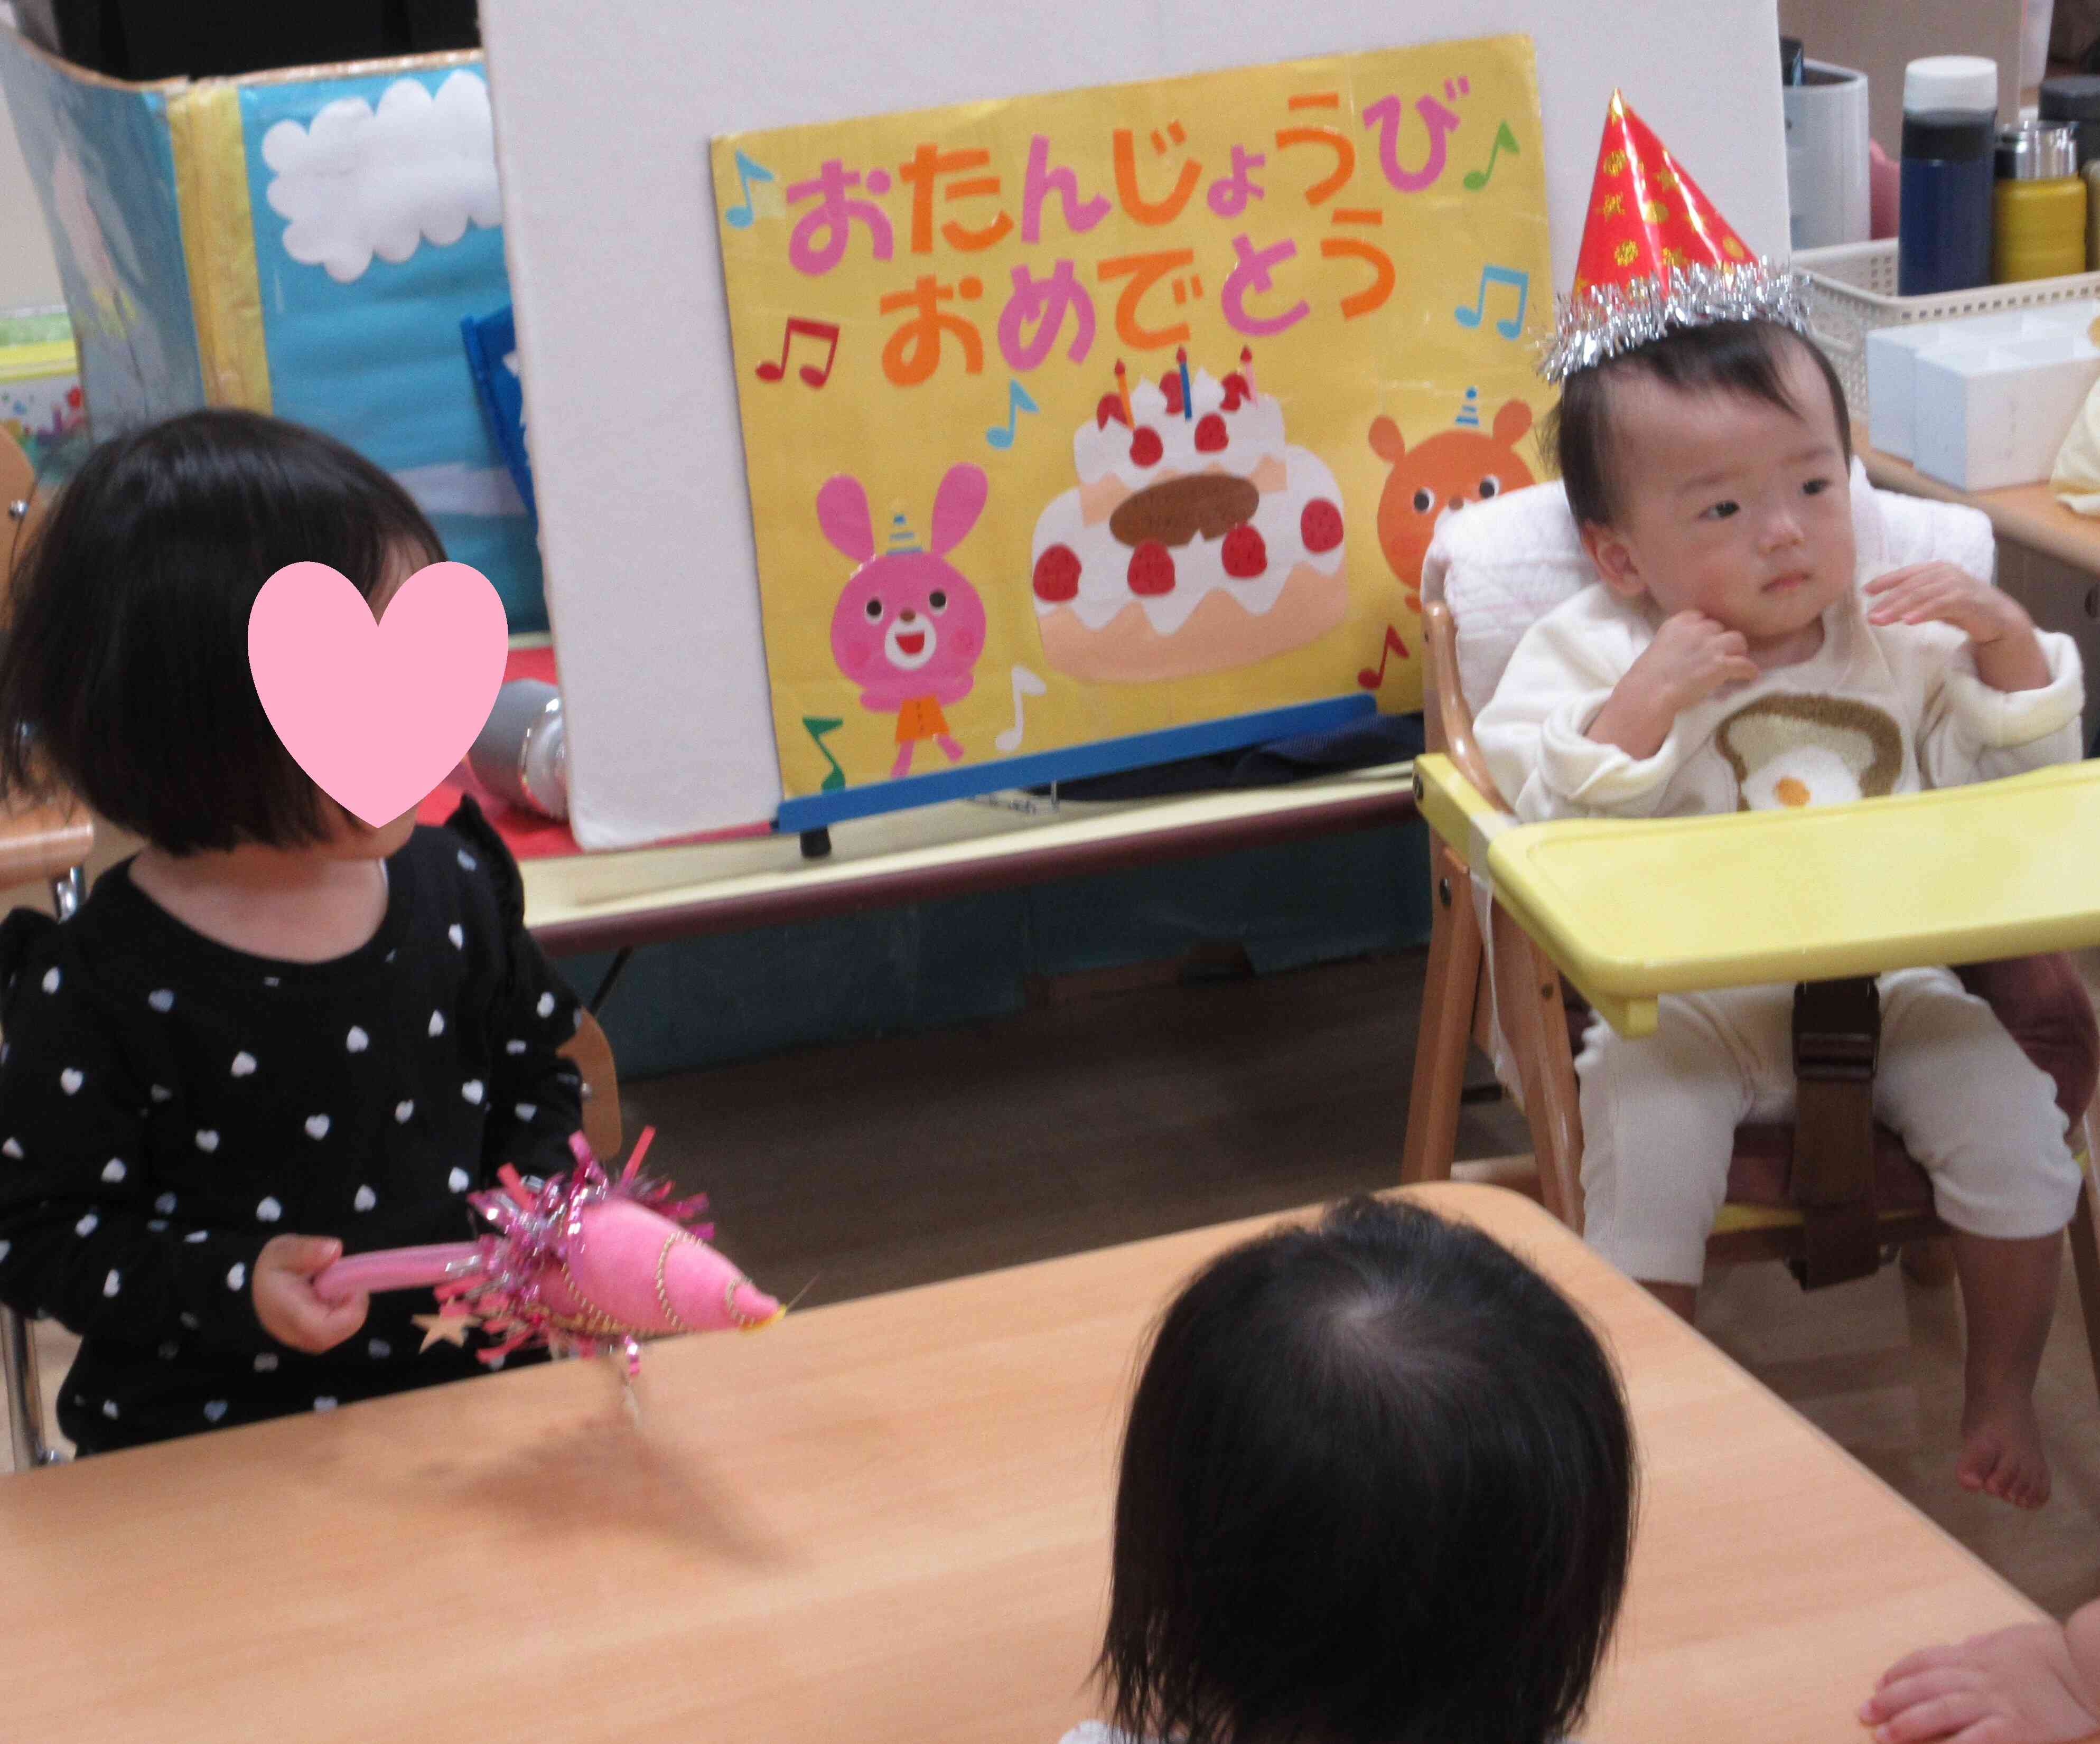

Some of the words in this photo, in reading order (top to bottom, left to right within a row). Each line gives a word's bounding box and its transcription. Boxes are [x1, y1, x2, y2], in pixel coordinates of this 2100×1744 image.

[786, 77, 1470, 275] おたんじょうび
[879, 209, 1395, 387] おめでとう
